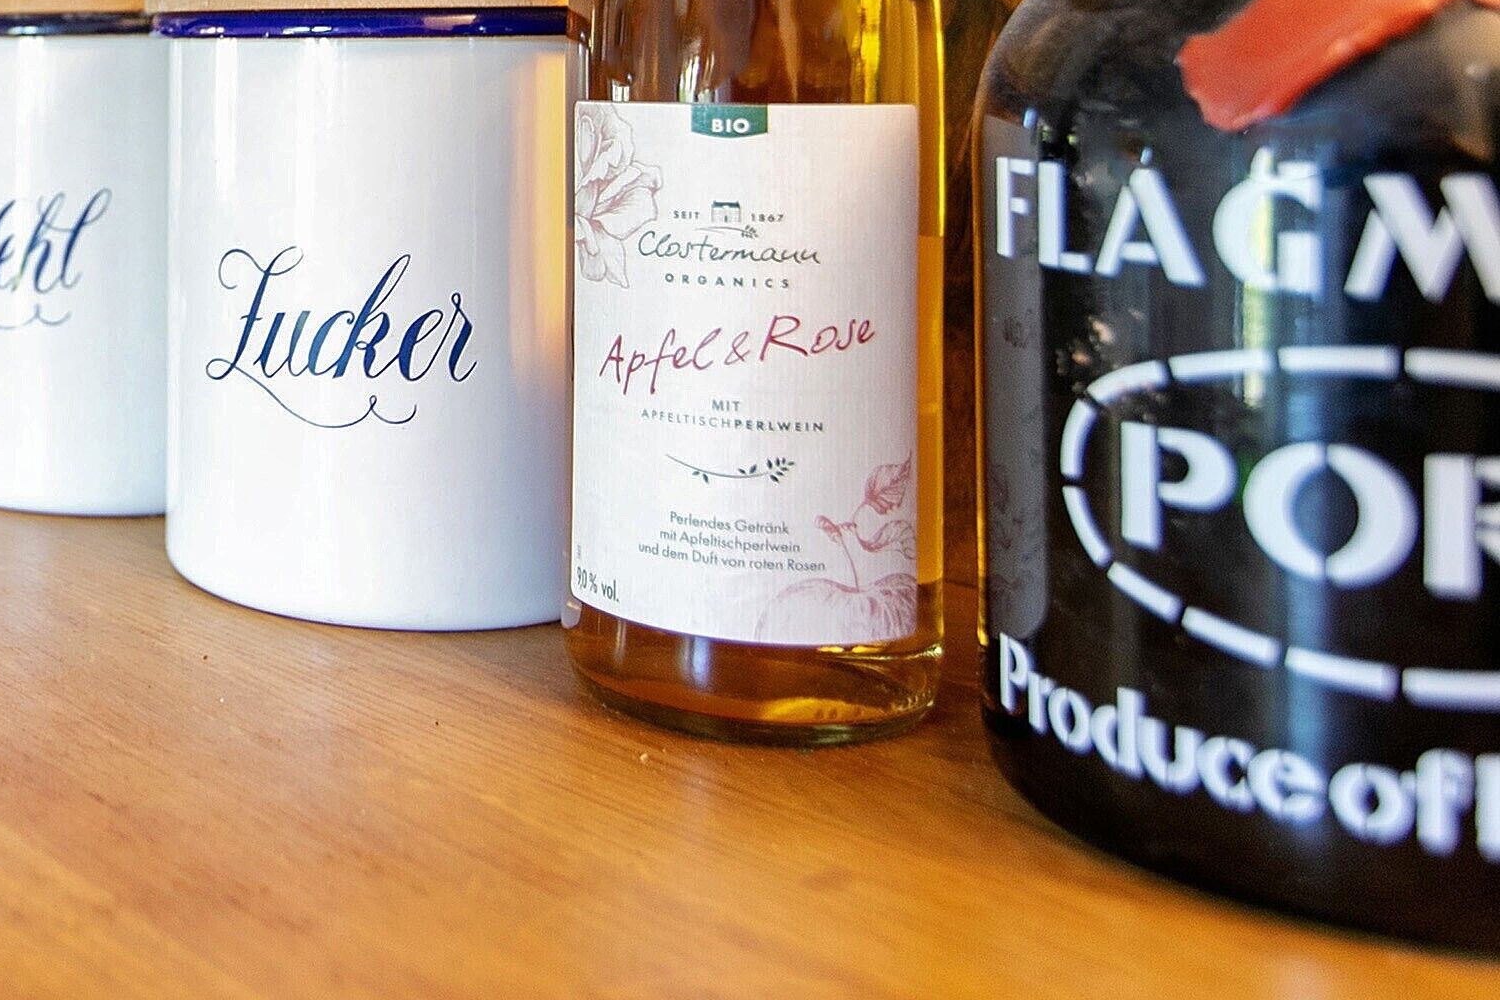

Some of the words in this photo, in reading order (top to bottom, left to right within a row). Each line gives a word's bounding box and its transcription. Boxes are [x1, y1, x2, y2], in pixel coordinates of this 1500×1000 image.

[711, 118, 750, 134] BIO
[673, 209, 701, 220] SEIT
[750, 213, 785, 223] 1867
[637, 230, 822, 265] Clostermann
[665, 273, 791, 289] ORGANICS
[204, 244, 478, 429] Zucker
[599, 328, 724, 396] Apfel
[724, 331, 751, 367] &
[758, 314, 876, 362] Rose
[711, 399, 741, 412] MIT
[640, 408, 825, 433] APFELTISCHPERLWEIN
[669, 510, 732, 532] Perlendes
[733, 518, 790, 536] Getränk
[659, 529, 677, 541] mit
[679, 530, 801, 554] Apfeltischperlwein
[638, 542, 660, 556] und
[661, 546, 689, 561] dem
[691, 549, 719, 566] Duft
[720, 556, 746, 569] von
[748, 558, 784, 571] roten
[786, 558, 826, 572] Rosen
[601, 579, 620, 603] vol.
[998, 632, 1327, 825] Produce
